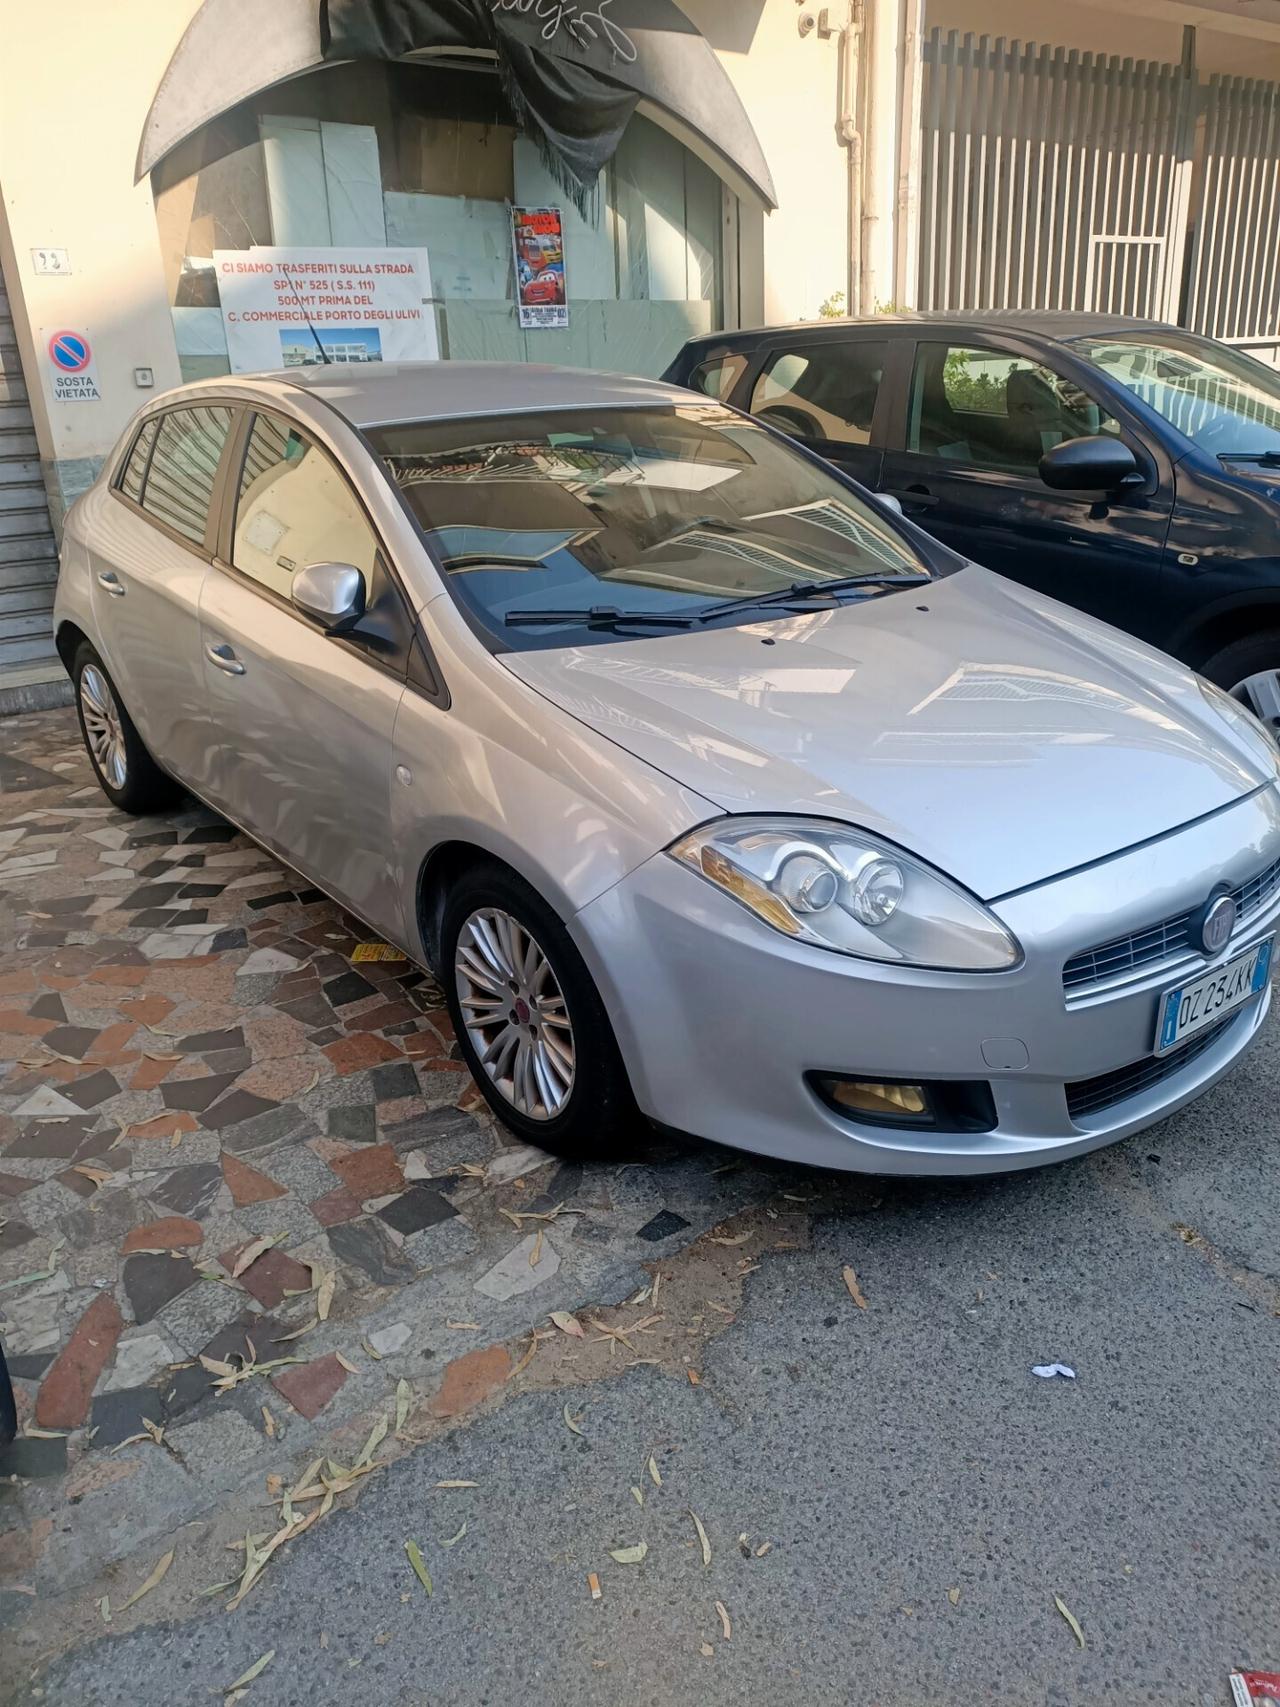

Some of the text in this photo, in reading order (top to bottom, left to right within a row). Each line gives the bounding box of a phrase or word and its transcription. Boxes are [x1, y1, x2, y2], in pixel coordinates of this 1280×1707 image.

[222, 263, 415, 273] CI SIAMO TRASFERITI SULLA STRADA
[309, 280, 328, 290] 525
[277, 295, 374, 305] 500 MT PRIMA DEL
[227, 309, 421, 322] C. COMMERCIALE PORTO DEGLI ULIVI
[56, 377, 94, 387] SOSTA
[55, 388, 99, 399] VIETATA
[1178, 987, 1203, 1030] DZ
[1203, 956, 1258, 1015] 234KK
